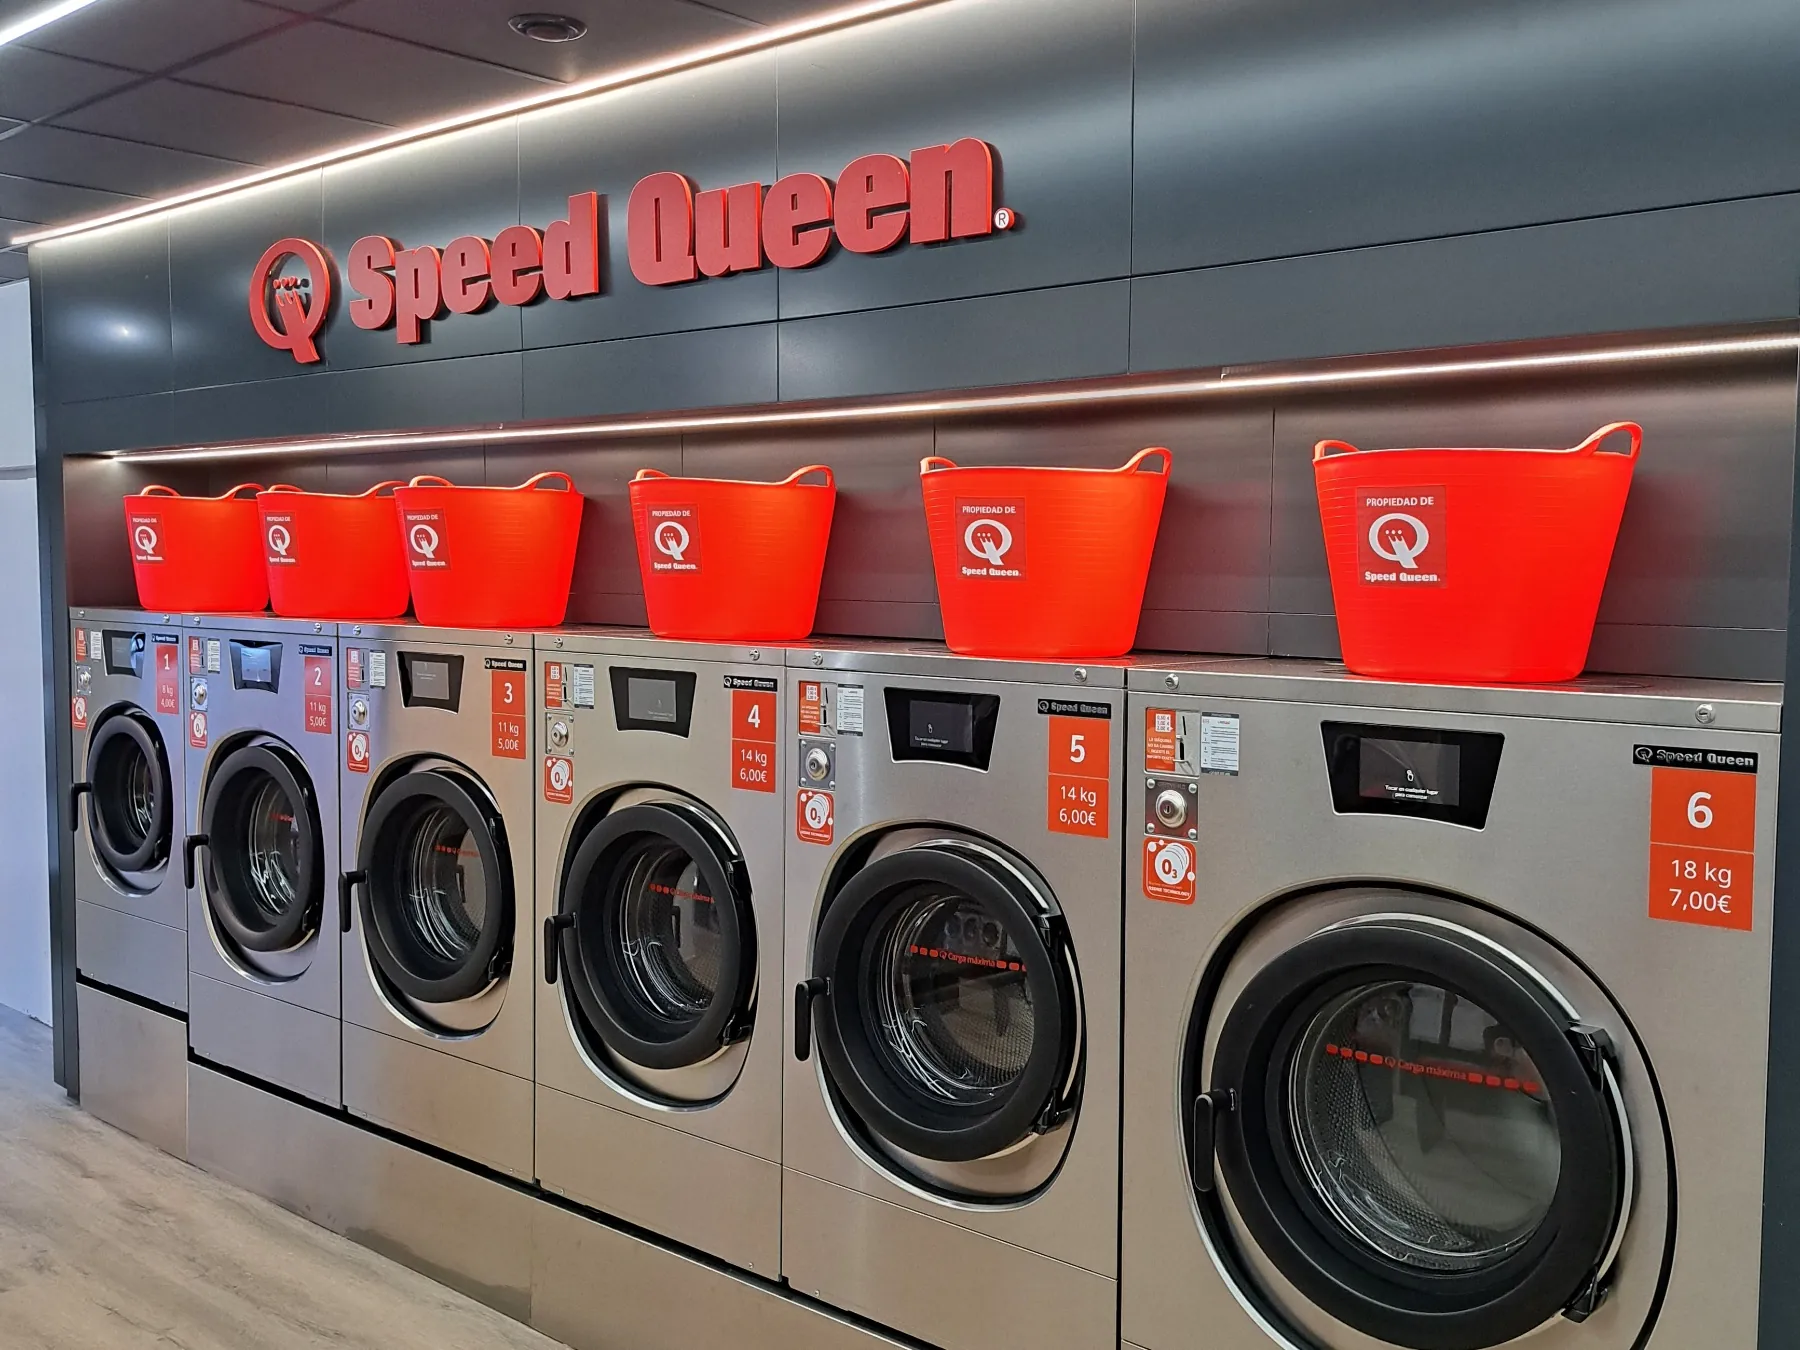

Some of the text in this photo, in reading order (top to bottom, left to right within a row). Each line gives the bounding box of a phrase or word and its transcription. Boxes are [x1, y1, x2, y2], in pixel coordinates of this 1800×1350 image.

[349, 190, 600, 344] Speed
[962, 505, 1016, 514] PROPIEDAD DE
[1366, 496, 1434, 507] PROPIEDAD DE
[1364, 571, 1397, 583] Speed
[164, 653, 170, 670] 1
[314, 666, 322, 686] 2
[504, 682, 513, 704] 3
[310, 702, 326, 714] 11 kg
[747, 704, 760, 728] 4
[1051, 702, 1078, 713] Speed
[1080, 704, 1108, 714] Queen
[310, 716, 326, 727] 5,00€
[498, 721, 519, 736] 11 kg
[498, 738, 519, 751] 5,00€
[1070, 735, 1086, 763] 5
[741, 749, 767, 766] 14 kg
[1656, 749, 1702, 763] Speed
[1707, 752, 1754, 767] Queen
[740, 768, 767, 783] 6,00€
[1061, 785, 1097, 806] 14 kg
[1059, 808, 1097, 826] 6,00€
[1687, 791, 1713, 829] 6
[1671, 859, 1732, 889] 18 kg
[1669, 888, 1732, 914] 7,00€
[1398, 1059, 1424, 1075] Carga
